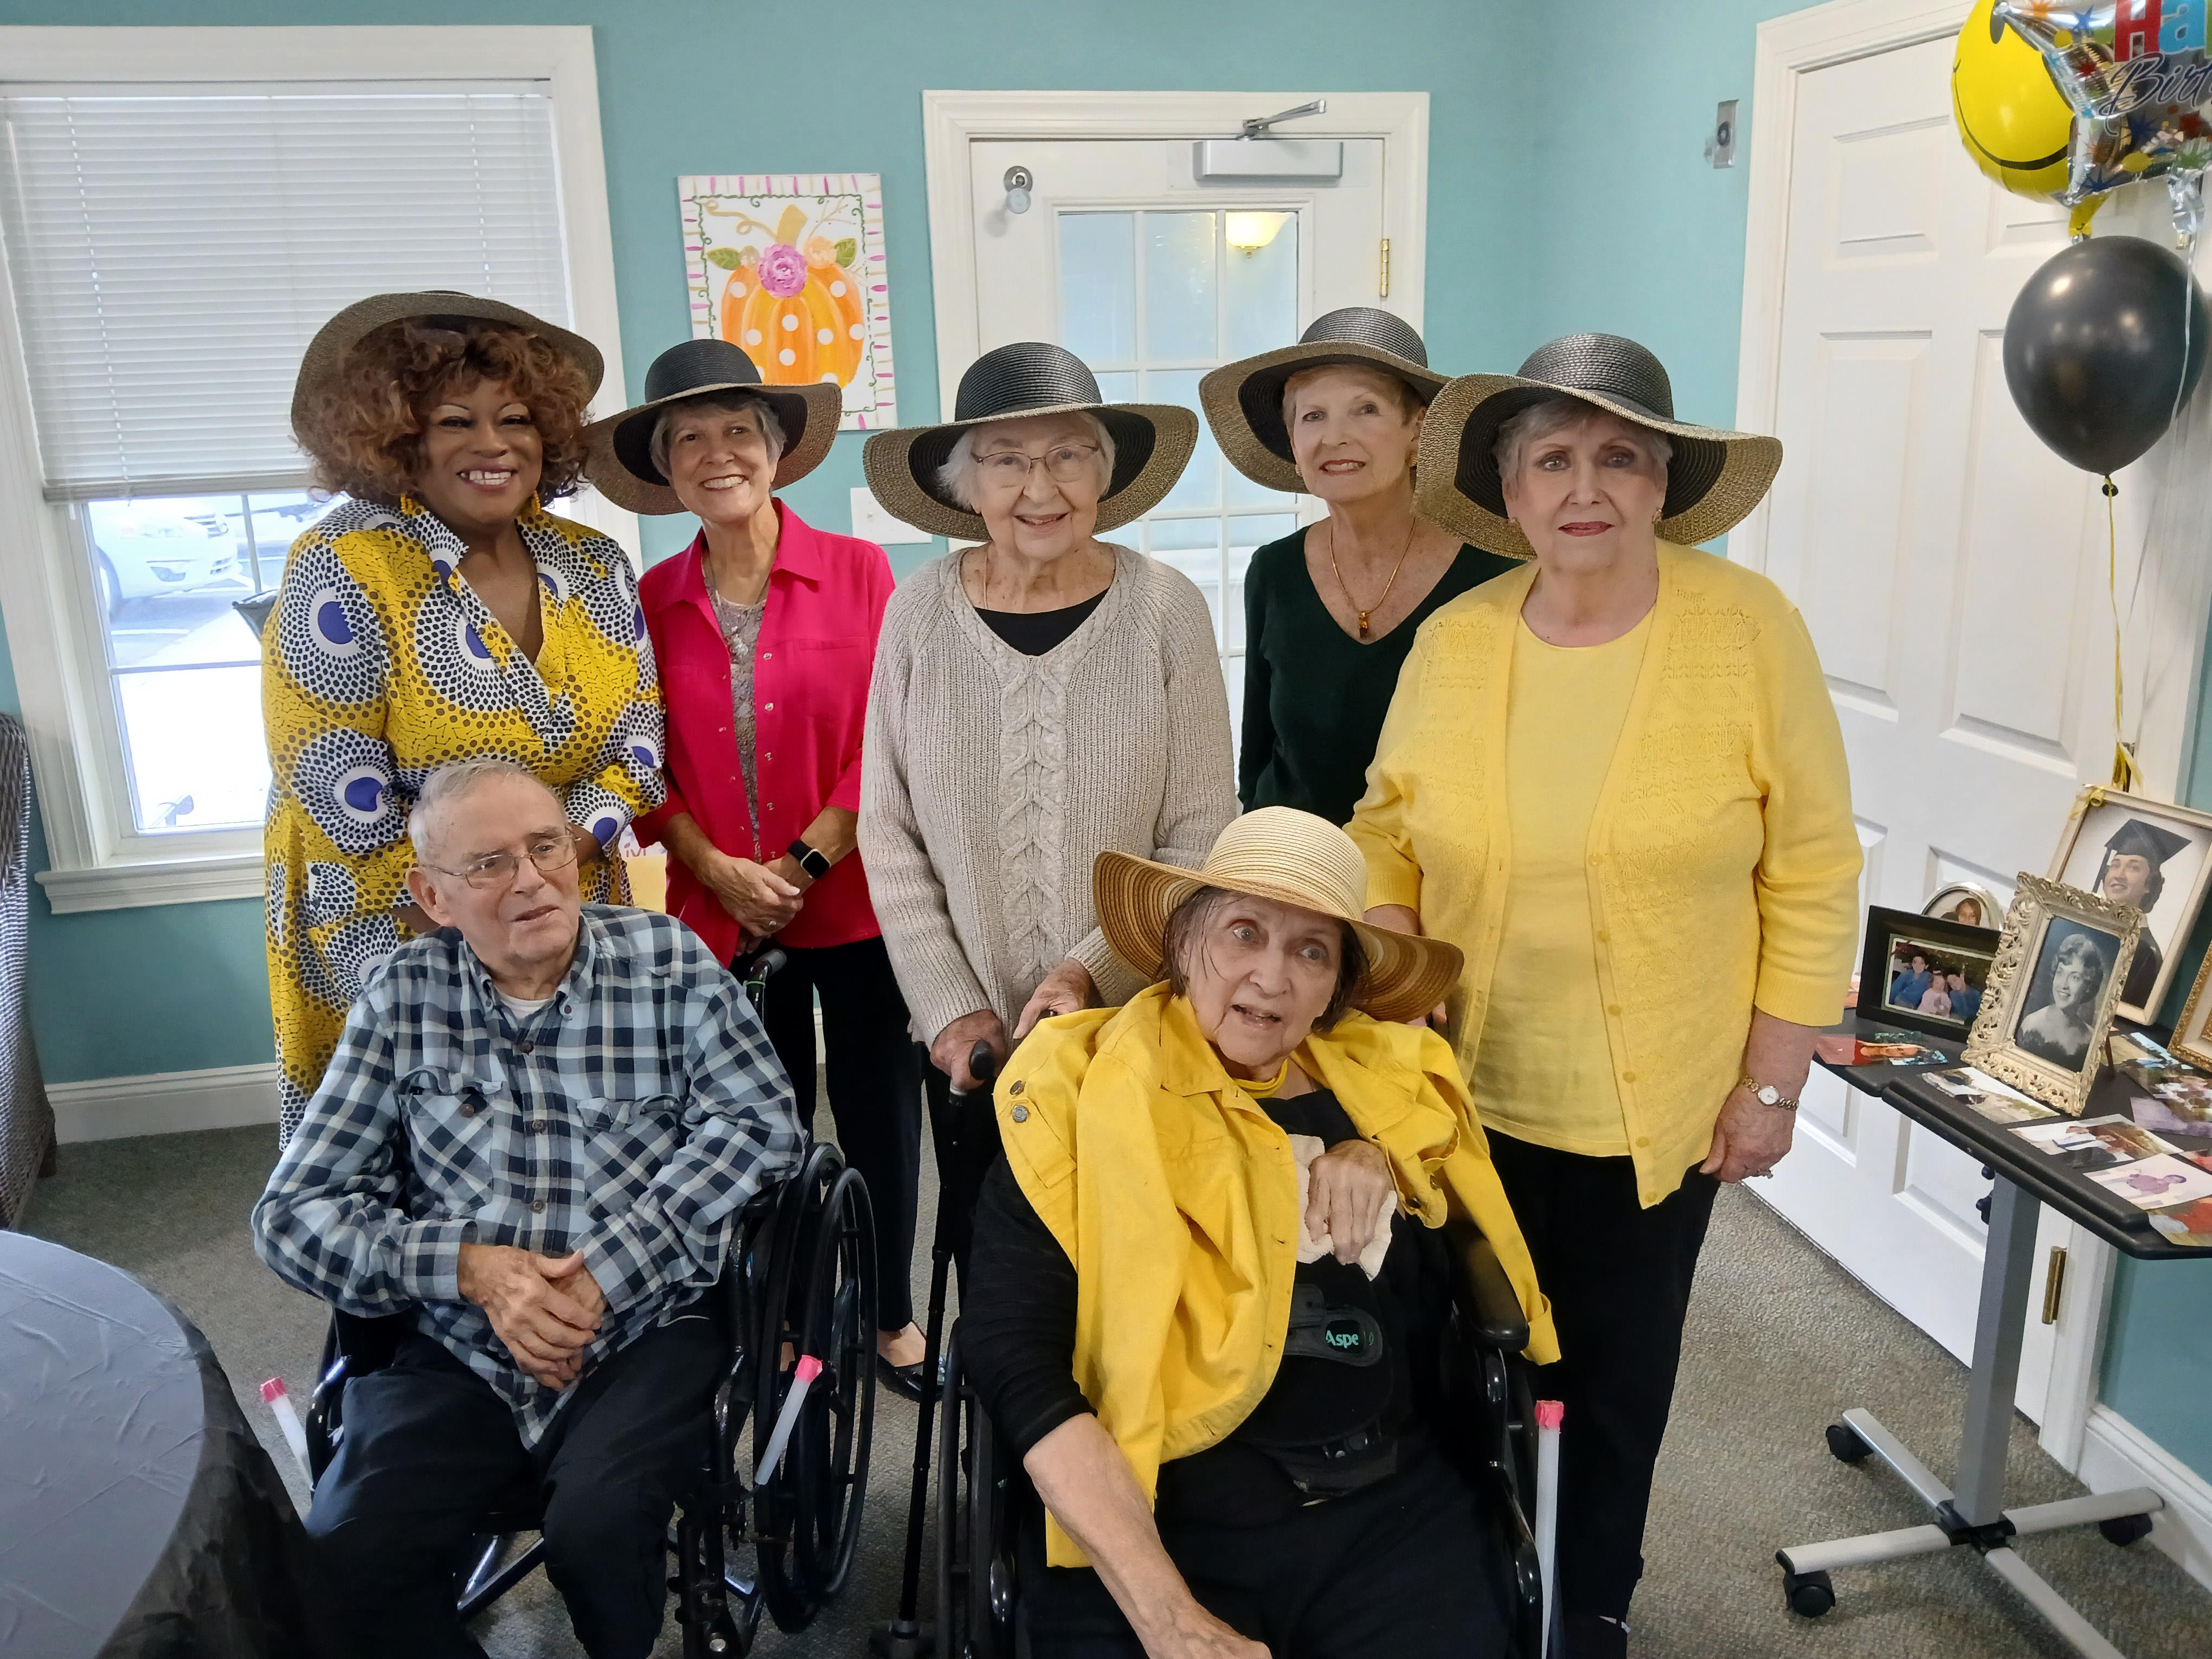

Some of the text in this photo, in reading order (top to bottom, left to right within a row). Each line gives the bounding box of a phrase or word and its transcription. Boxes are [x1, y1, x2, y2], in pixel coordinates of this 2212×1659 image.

[2114, 0, 2212, 62] Ha
[2099, 52, 2212, 137] Birt
[1326, 1330, 1359, 1348] Aspe
